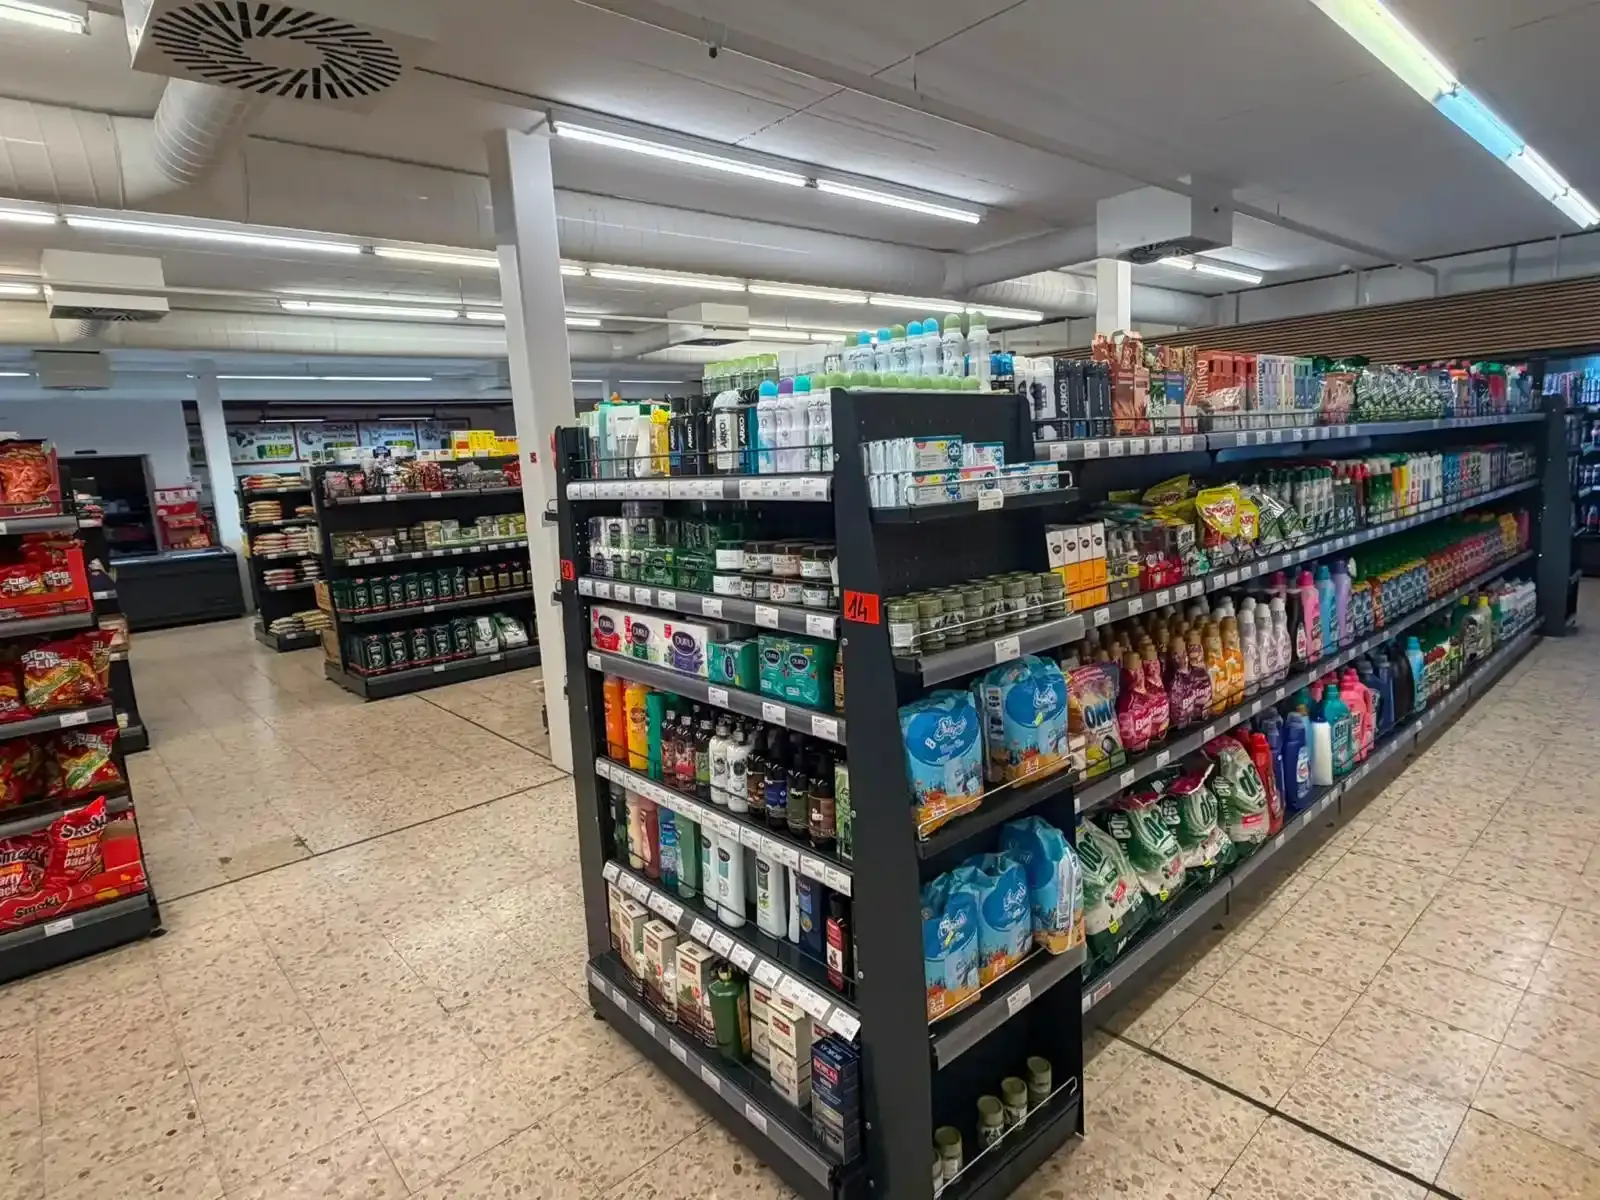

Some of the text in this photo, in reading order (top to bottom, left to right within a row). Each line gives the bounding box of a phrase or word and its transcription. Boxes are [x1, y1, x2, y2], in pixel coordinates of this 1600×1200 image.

[848, 594, 868, 621] 14
[675, 635, 694, 649] DURU
[60, 806, 107, 840] Smoki
[66, 843, 98, 858] party
[64, 854, 96, 868] pack
[0, 873, 21, 889] arty
[0, 884, 19, 898] ack
[14, 892, 61, 918] Smoki
